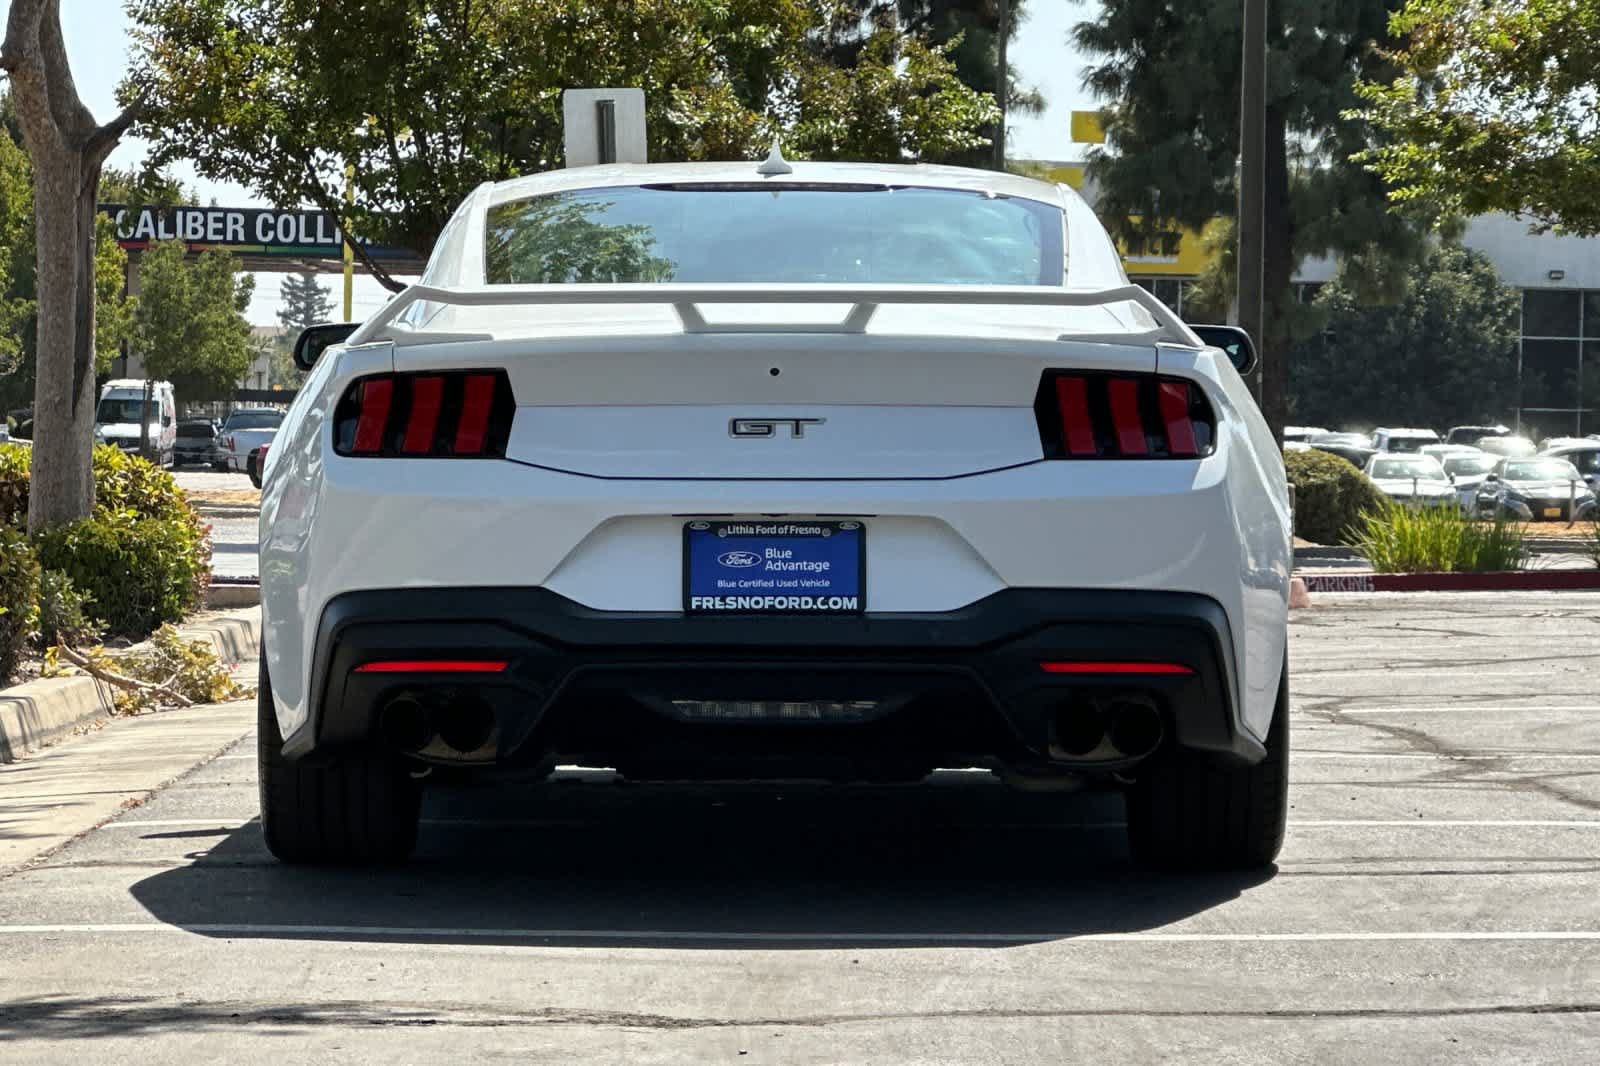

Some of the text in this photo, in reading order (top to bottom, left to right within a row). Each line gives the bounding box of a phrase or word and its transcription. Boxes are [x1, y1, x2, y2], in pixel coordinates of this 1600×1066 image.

[115, 209, 373, 245] CALIBER COLLI
[728, 417, 827, 440] GT
[727, 525, 821, 535] Lithia Ford of Fresno
[725, 553, 753, 566] Ford
[765, 548, 792, 559] Blue
[765, 560, 830, 572] Advantage
[717, 579, 830, 588] Blue Certified Used Vehicle
[1305, 575, 1375, 592] PARKING
[691, 596, 858, 610] FRESNOFORD.COM
